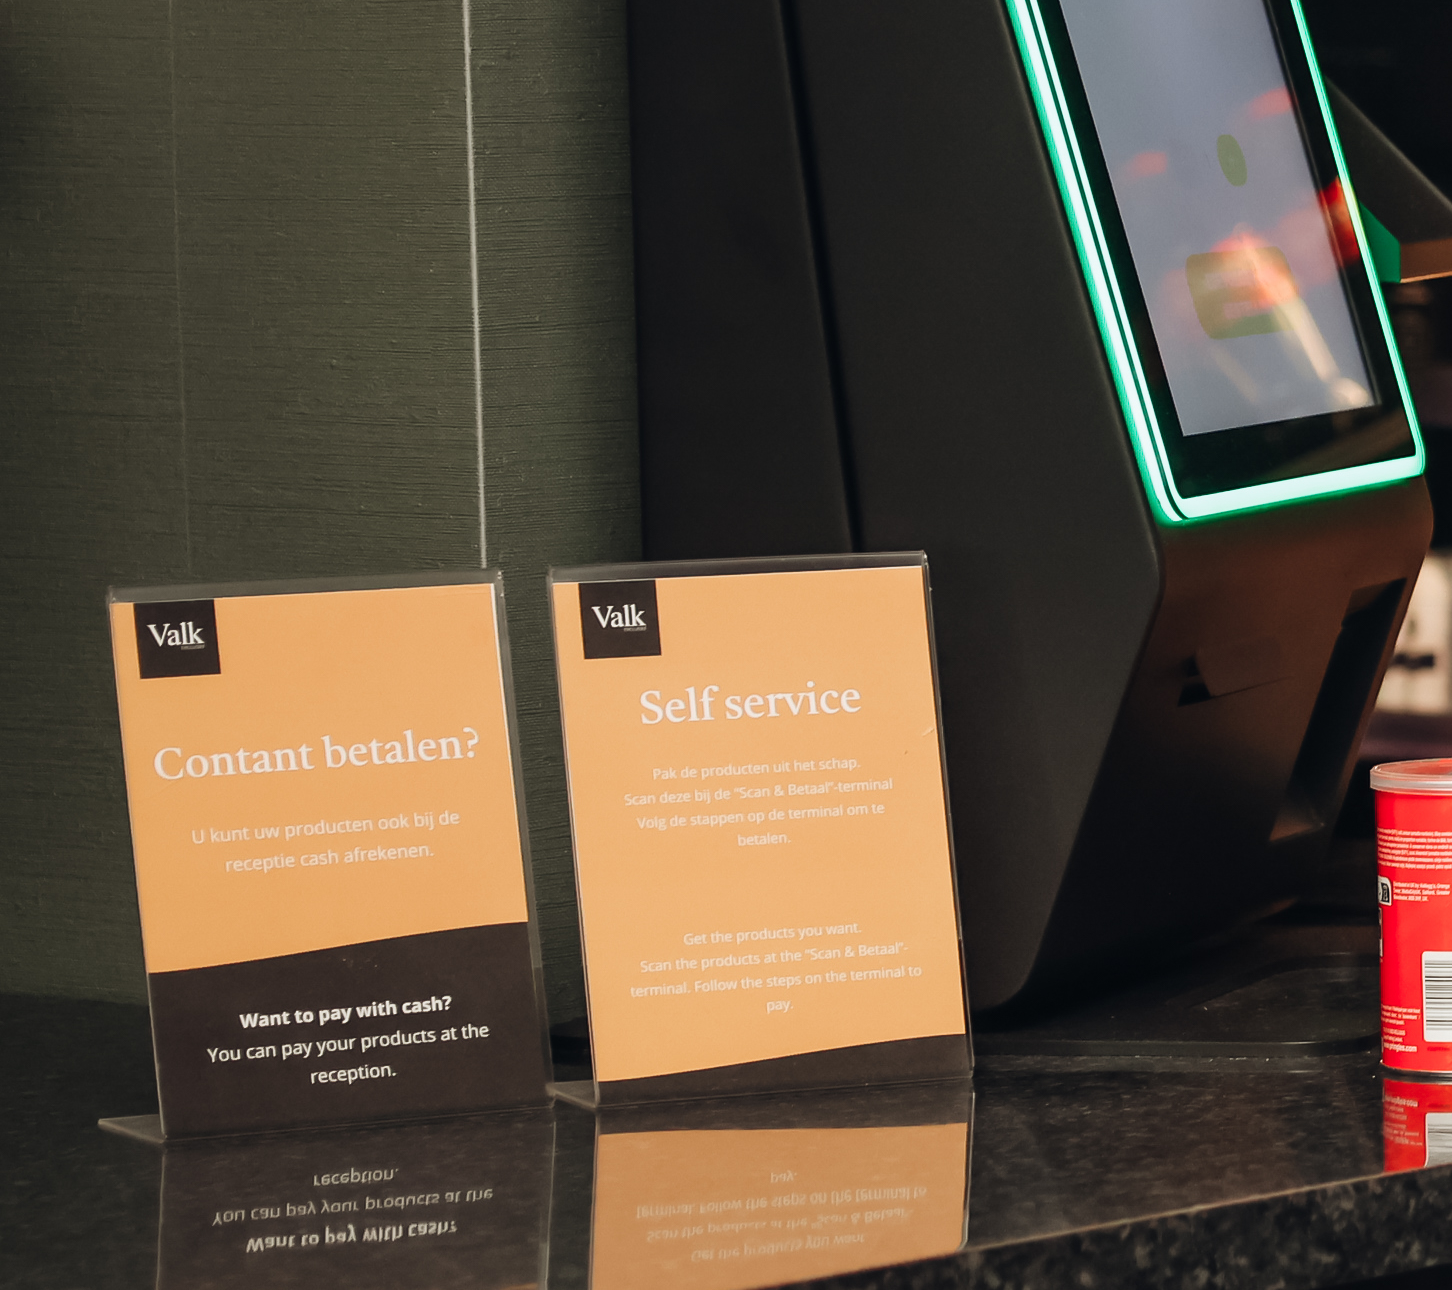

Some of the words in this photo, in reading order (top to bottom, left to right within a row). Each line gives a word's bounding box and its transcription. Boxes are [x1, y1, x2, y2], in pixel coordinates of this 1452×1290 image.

[590, 603, 647, 631] Valk
[146, 620, 206, 648] Valk
[639, 684, 720, 725] Self
[724, 680, 862, 720] service
[153, 743, 316, 781] Contant
[320, 726, 480, 769] betalen?
[652, 766, 678, 781] Pak
[679, 765, 699, 779] de
[700, 763, 771, 781] producten
[772, 760, 792, 774] uit
[792, 759, 817, 772] het
[817, 756, 862, 772] schap.
[623, 792, 657, 807] Scan
[658, 790, 693, 805] deze
[693, 788, 712, 805] bij
[713, 787, 732, 801] de
[773, 784, 786, 798] &
[191, 828, 207, 845] U
[209, 826, 251, 844] kunt
[253, 826, 281, 841] uw
[284, 818, 374, 842] producten
[377, 812, 411, 831] ook
[413, 811, 436, 832] bij
[438, 809, 461, 826] de
[635, 815, 668, 832] Volg
[668, 814, 688, 828] de
[689, 812, 746, 828] stappen
[746, 811, 766, 825] op
[767, 807, 786, 822] de
[787, 803, 845, 820] terminal
[845, 804, 870, 817] om
[870, 803, 886, 815] te
[736, 831, 792, 847] betalen.
[225, 852, 297, 875] receptie
[299, 848, 340, 867] cash
[343, 844, 435, 864] afrekenen.
[682, 932, 708, 947] Get
[709, 930, 734, 945] the
[735, 927, 796, 946] products
[796, 926, 824, 941] you
[824, 922, 863, 936] want.
[639, 959, 673, 974] Scan
[674, 957, 699, 971] the
[700, 953, 762, 972] products
[763, 951, 778, 965] at
[779, 949, 803, 963] the
[843, 945, 856, 959] &
[629, 980, 692, 999] terminal.
[693, 978, 739, 993] Follow
[739, 975, 764, 990] the
[765, 974, 803, 990] steps
[804, 973, 824, 985] on
[824, 969, 848, 984] the
[849, 964, 907, 982] terminal
[907, 965, 923, 978] to
[238, 1010, 292, 1029] Want
[293, 1009, 315, 1024] to
[318, 1006, 353, 1027] pay
[355, 999, 398, 1019] with
[401, 994, 453, 1015] cash?
[765, 999, 795, 1015] pay.
[206, 1047, 242, 1064] You
[245, 1044, 277, 1060] can
[281, 1041, 313, 1061] pay
[315, 1037, 357, 1058] your
[360, 1029, 437, 1054] products
[440, 1026, 459, 1042] at
[460, 1022, 490, 1040] the
[310, 1063, 397, 1086] reception.
